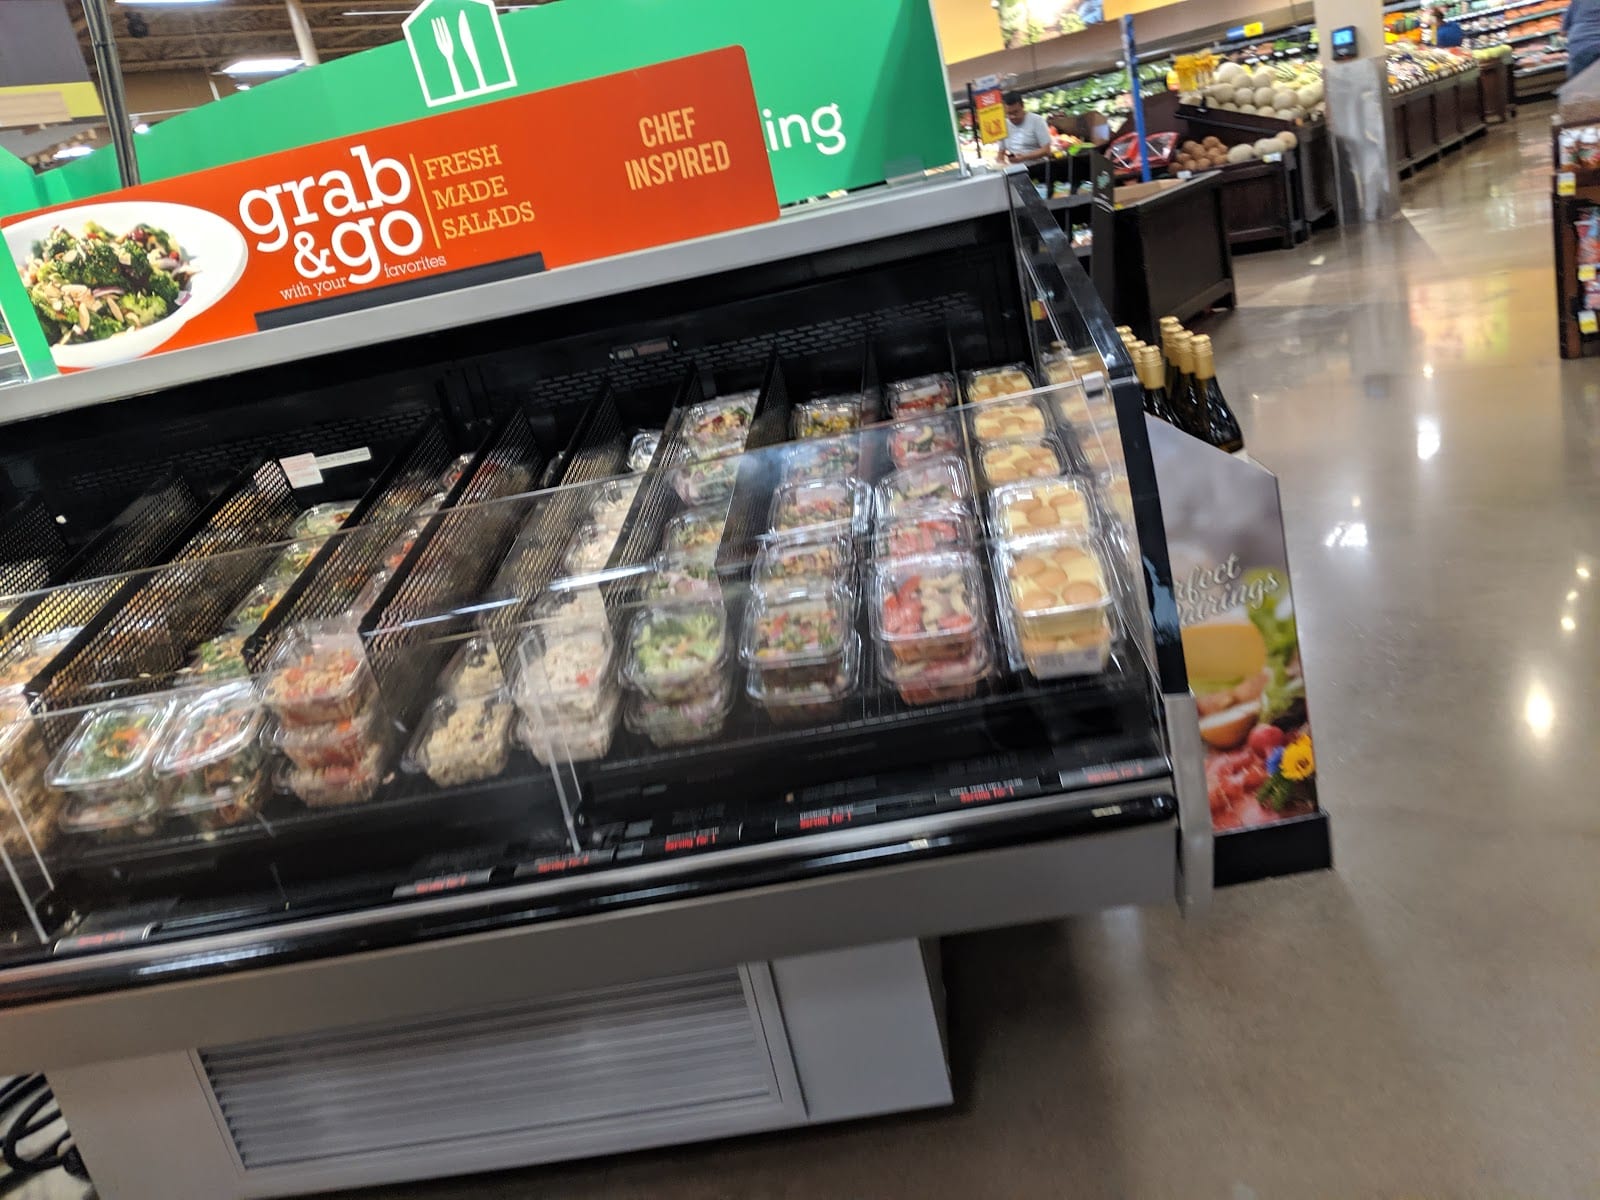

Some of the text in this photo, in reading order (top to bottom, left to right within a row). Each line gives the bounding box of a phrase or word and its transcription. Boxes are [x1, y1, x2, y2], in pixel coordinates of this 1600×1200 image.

[638, 106, 697, 149] CHEF
[762, 103, 847, 155] ing
[422, 143, 503, 180] FRESH
[624, 139, 731, 191] INSPIRED
[239, 144, 412, 253] grab
[432, 174, 509, 210] MADE
[441, 200, 536, 240] SALADS
[279, 254, 447, 301] with your favorites
[1173, 552, 1241, 605] rfect
